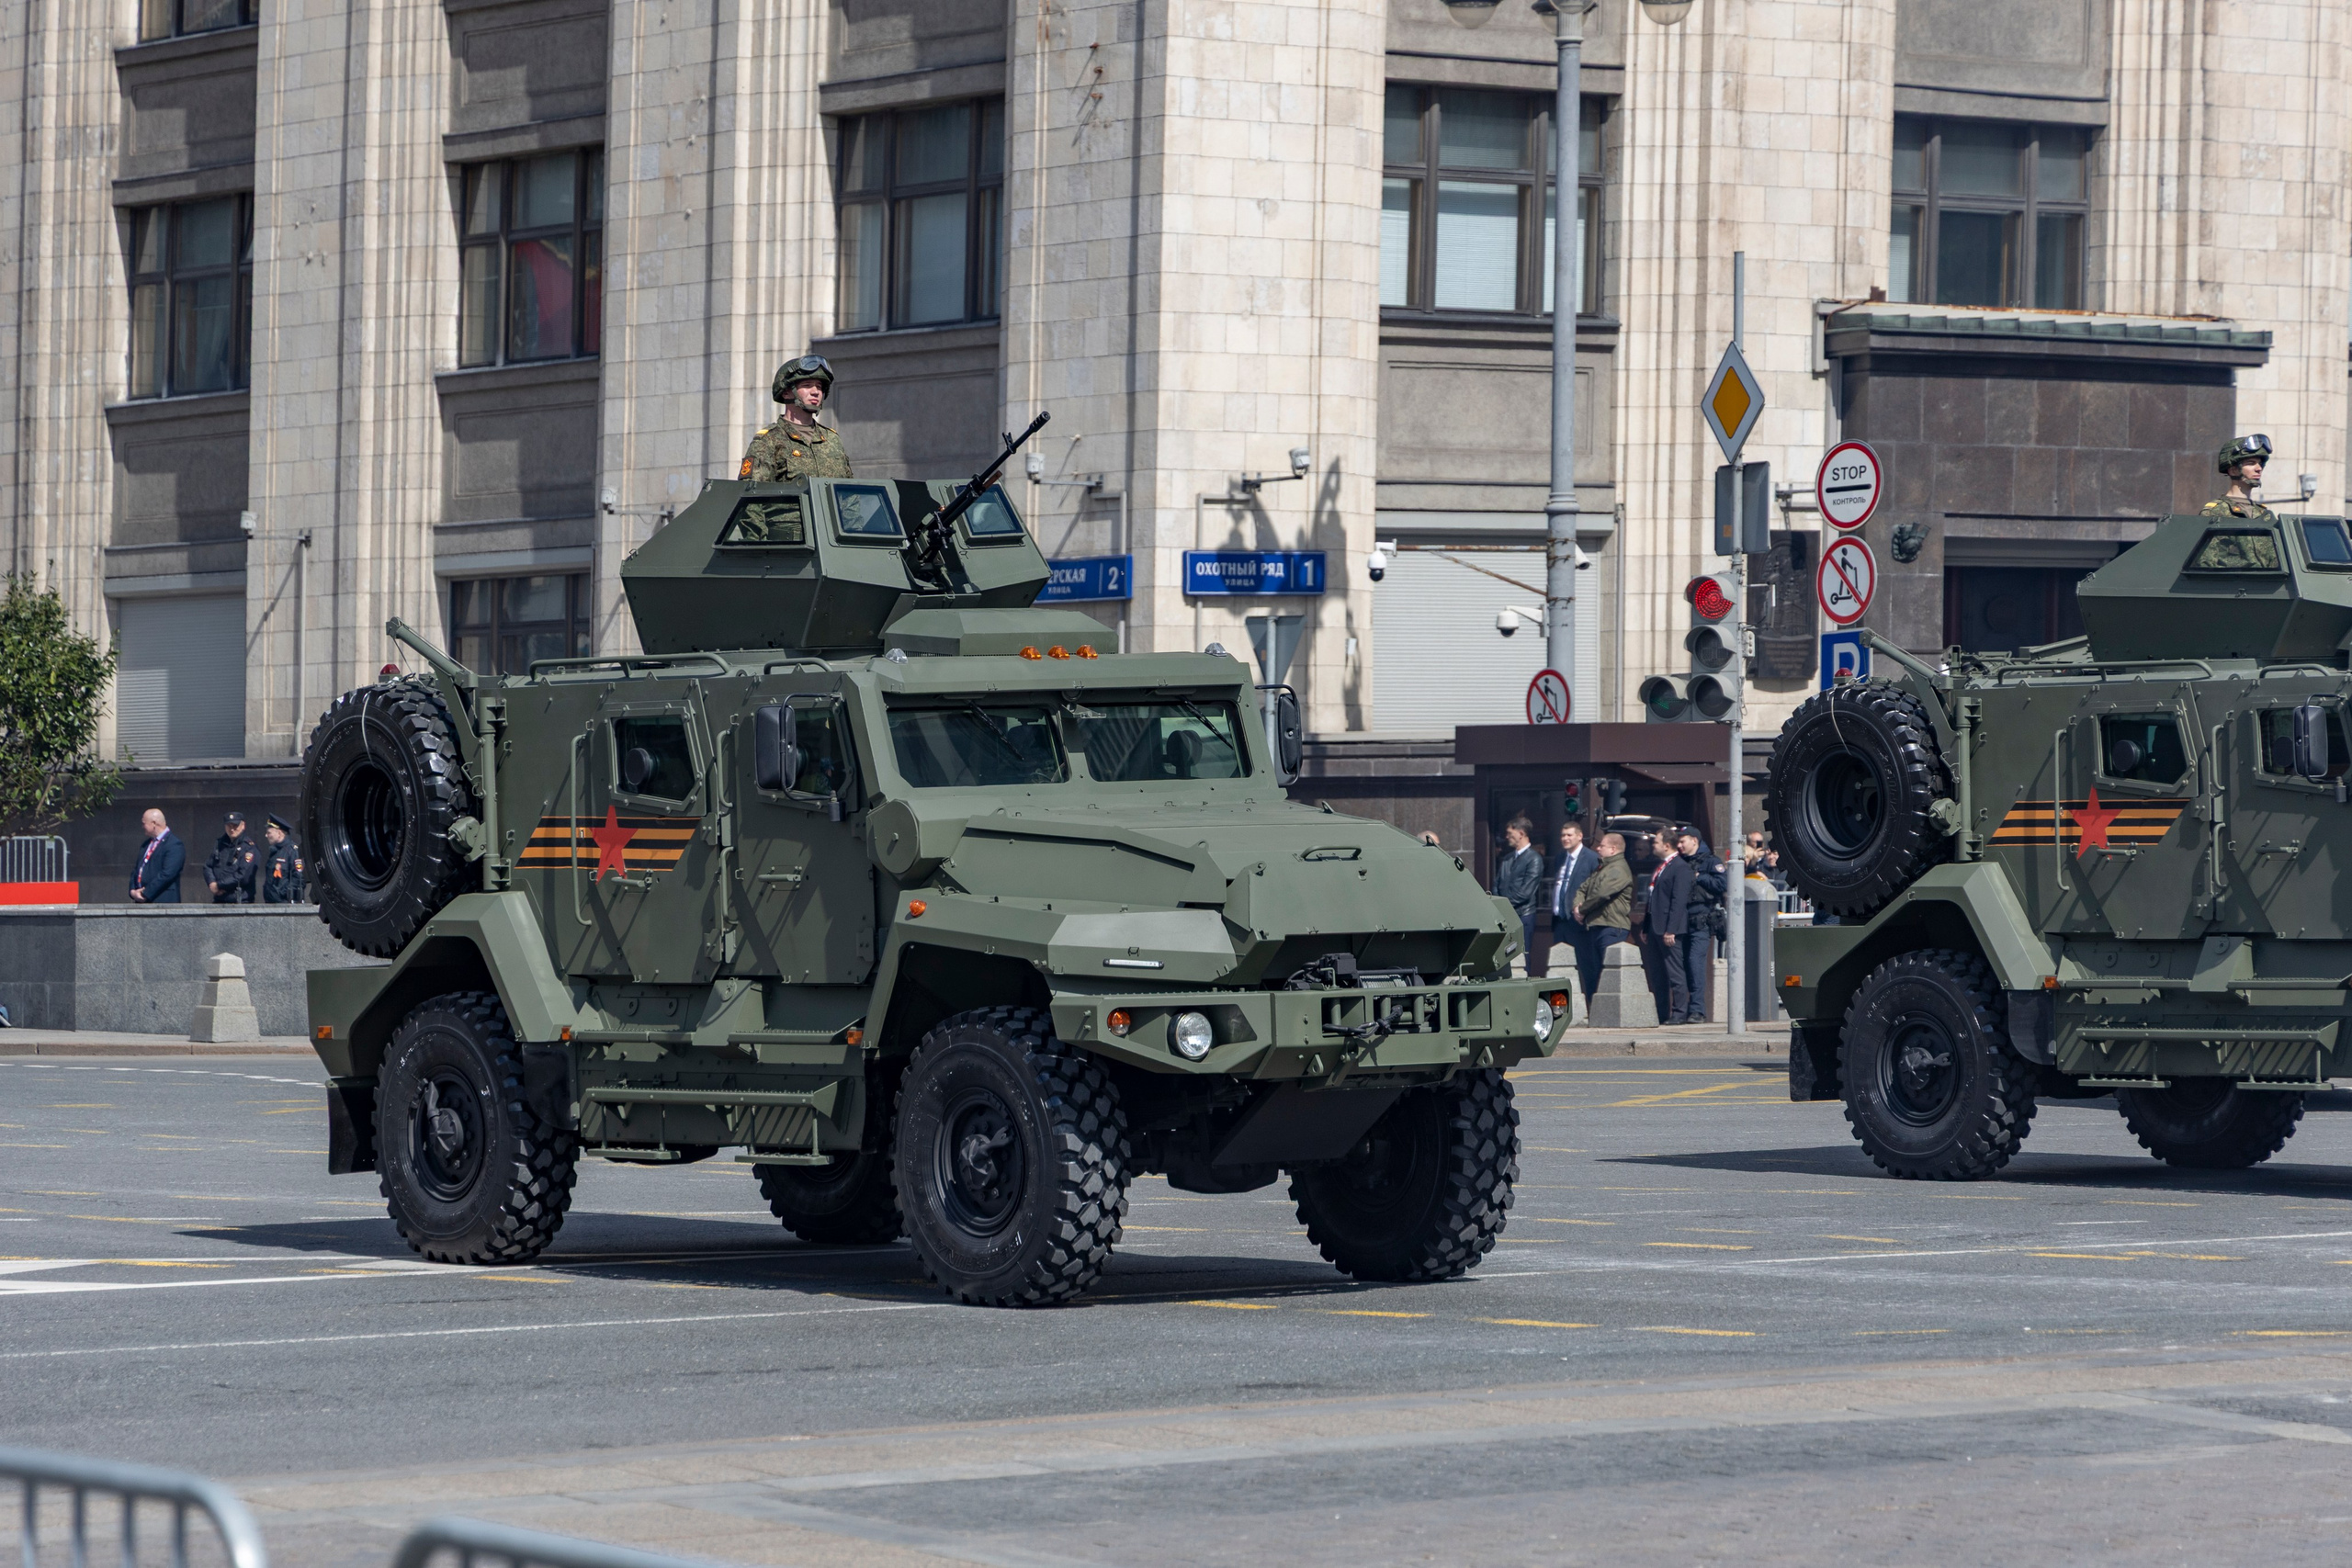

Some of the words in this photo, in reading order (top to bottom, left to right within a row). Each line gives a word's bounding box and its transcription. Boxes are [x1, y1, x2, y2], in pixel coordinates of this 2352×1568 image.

[1832, 465, 1867, 481] STOP
[1832, 496, 1866, 505] КОНТРОЛЬ
[1047, 568, 1087, 584] РСКАЯ
[1195, 559, 1257, 576] ОХОТНЫЙ
[1260, 561, 1285, 578] РЯД
[1304, 558, 1315, 586] 1
[1107, 566, 1119, 591] 2
[1225, 578, 1255, 586] УЛИЦА
[1833, 642, 1860, 687] P
